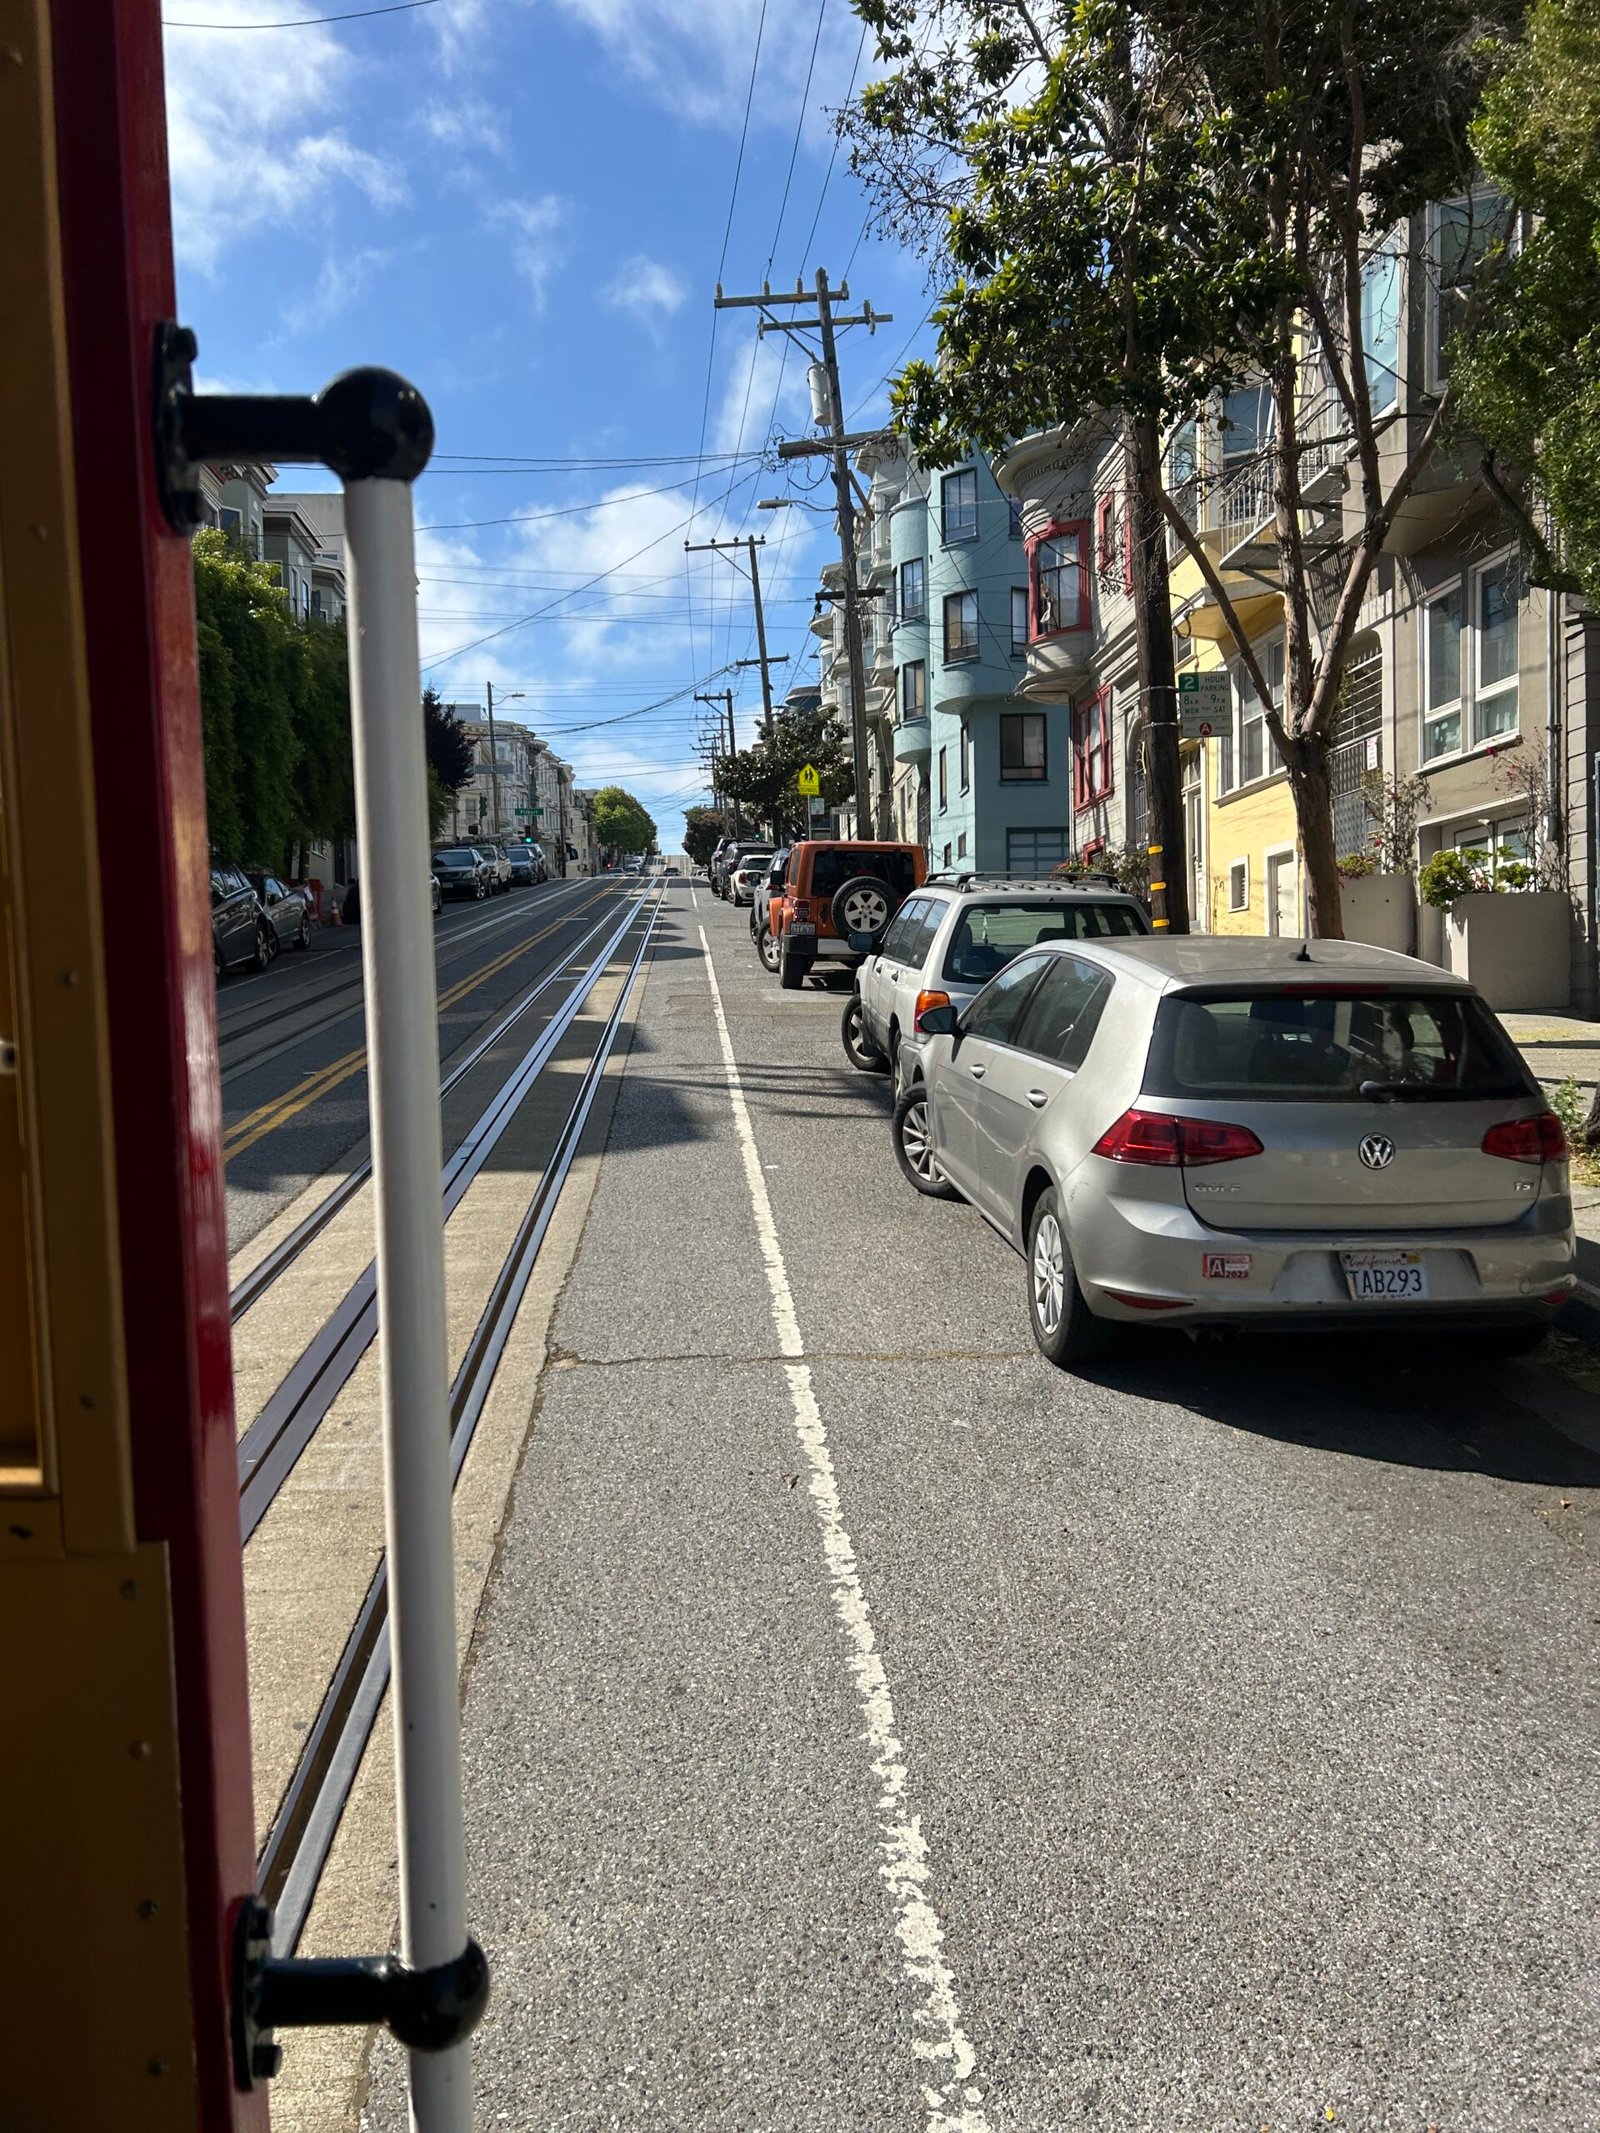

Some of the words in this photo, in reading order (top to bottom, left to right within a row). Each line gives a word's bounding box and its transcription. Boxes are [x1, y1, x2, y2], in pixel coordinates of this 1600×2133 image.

[1184, 676, 1195, 689] 2
[1200, 684, 1229, 692] PARKING
[1214, 705, 1226, 713] SAT
[1202, 723, 1210, 733] A
[1348, 1254, 1404, 1269] California
[1210, 1259, 1224, 1276] A
